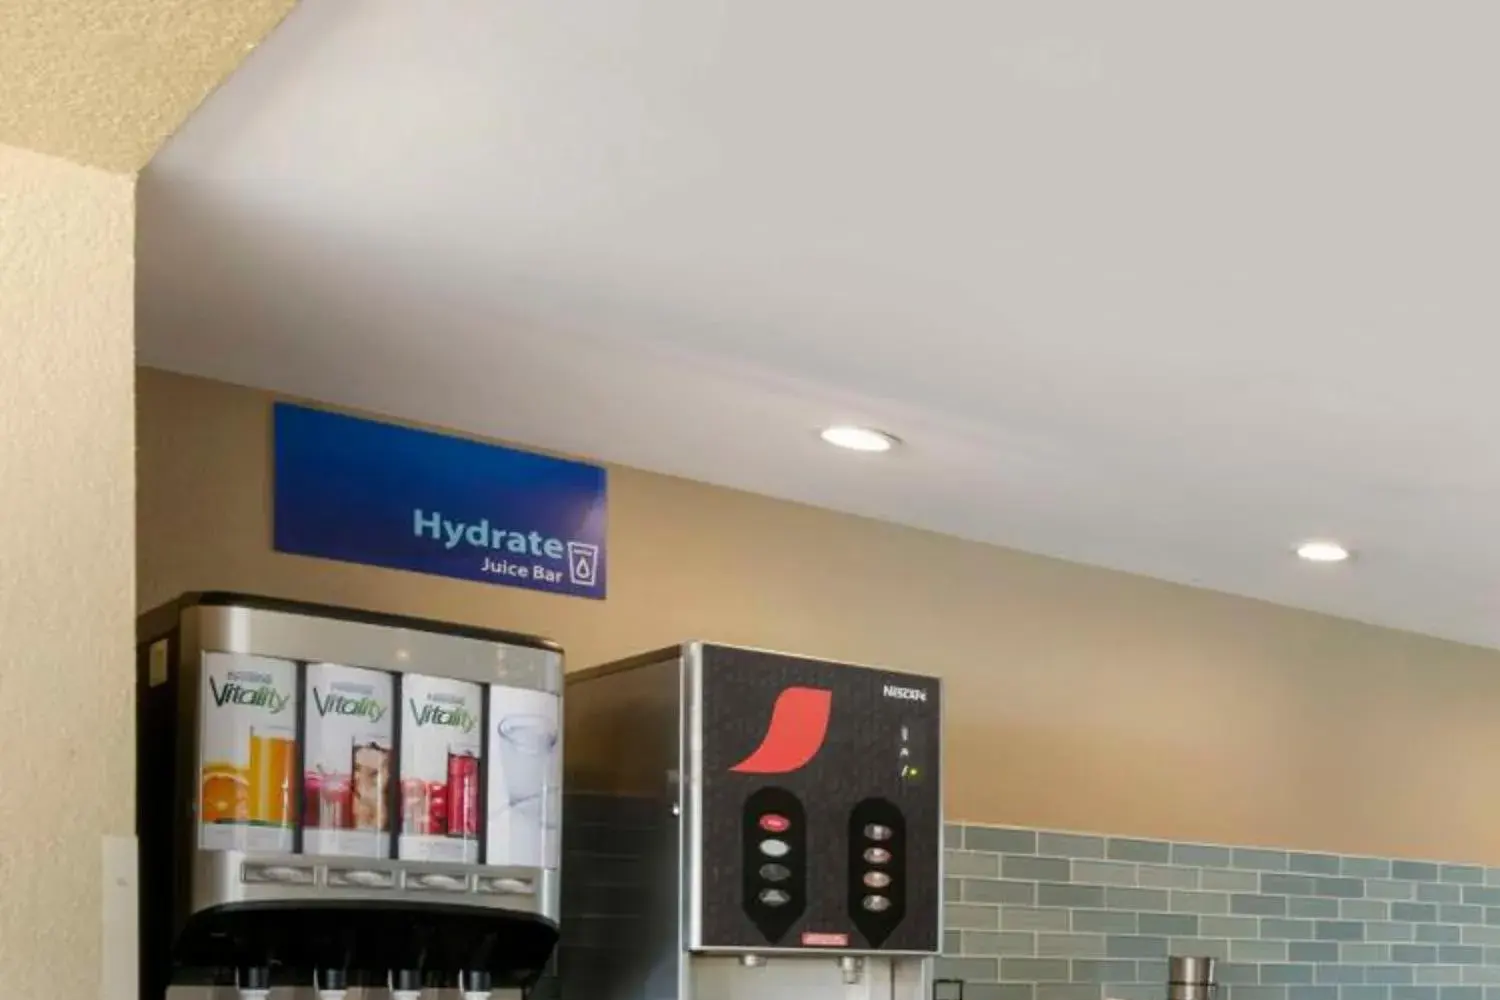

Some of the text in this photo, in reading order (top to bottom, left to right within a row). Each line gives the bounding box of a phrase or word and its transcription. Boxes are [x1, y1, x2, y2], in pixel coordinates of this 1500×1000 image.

[413, 508, 564, 559] Hydrate
[481, 556, 564, 584] Juice Bar
[209, 675, 290, 714] Vitality
[313, 687, 388, 723] Vitality
[409, 697, 478, 733] Vitality
